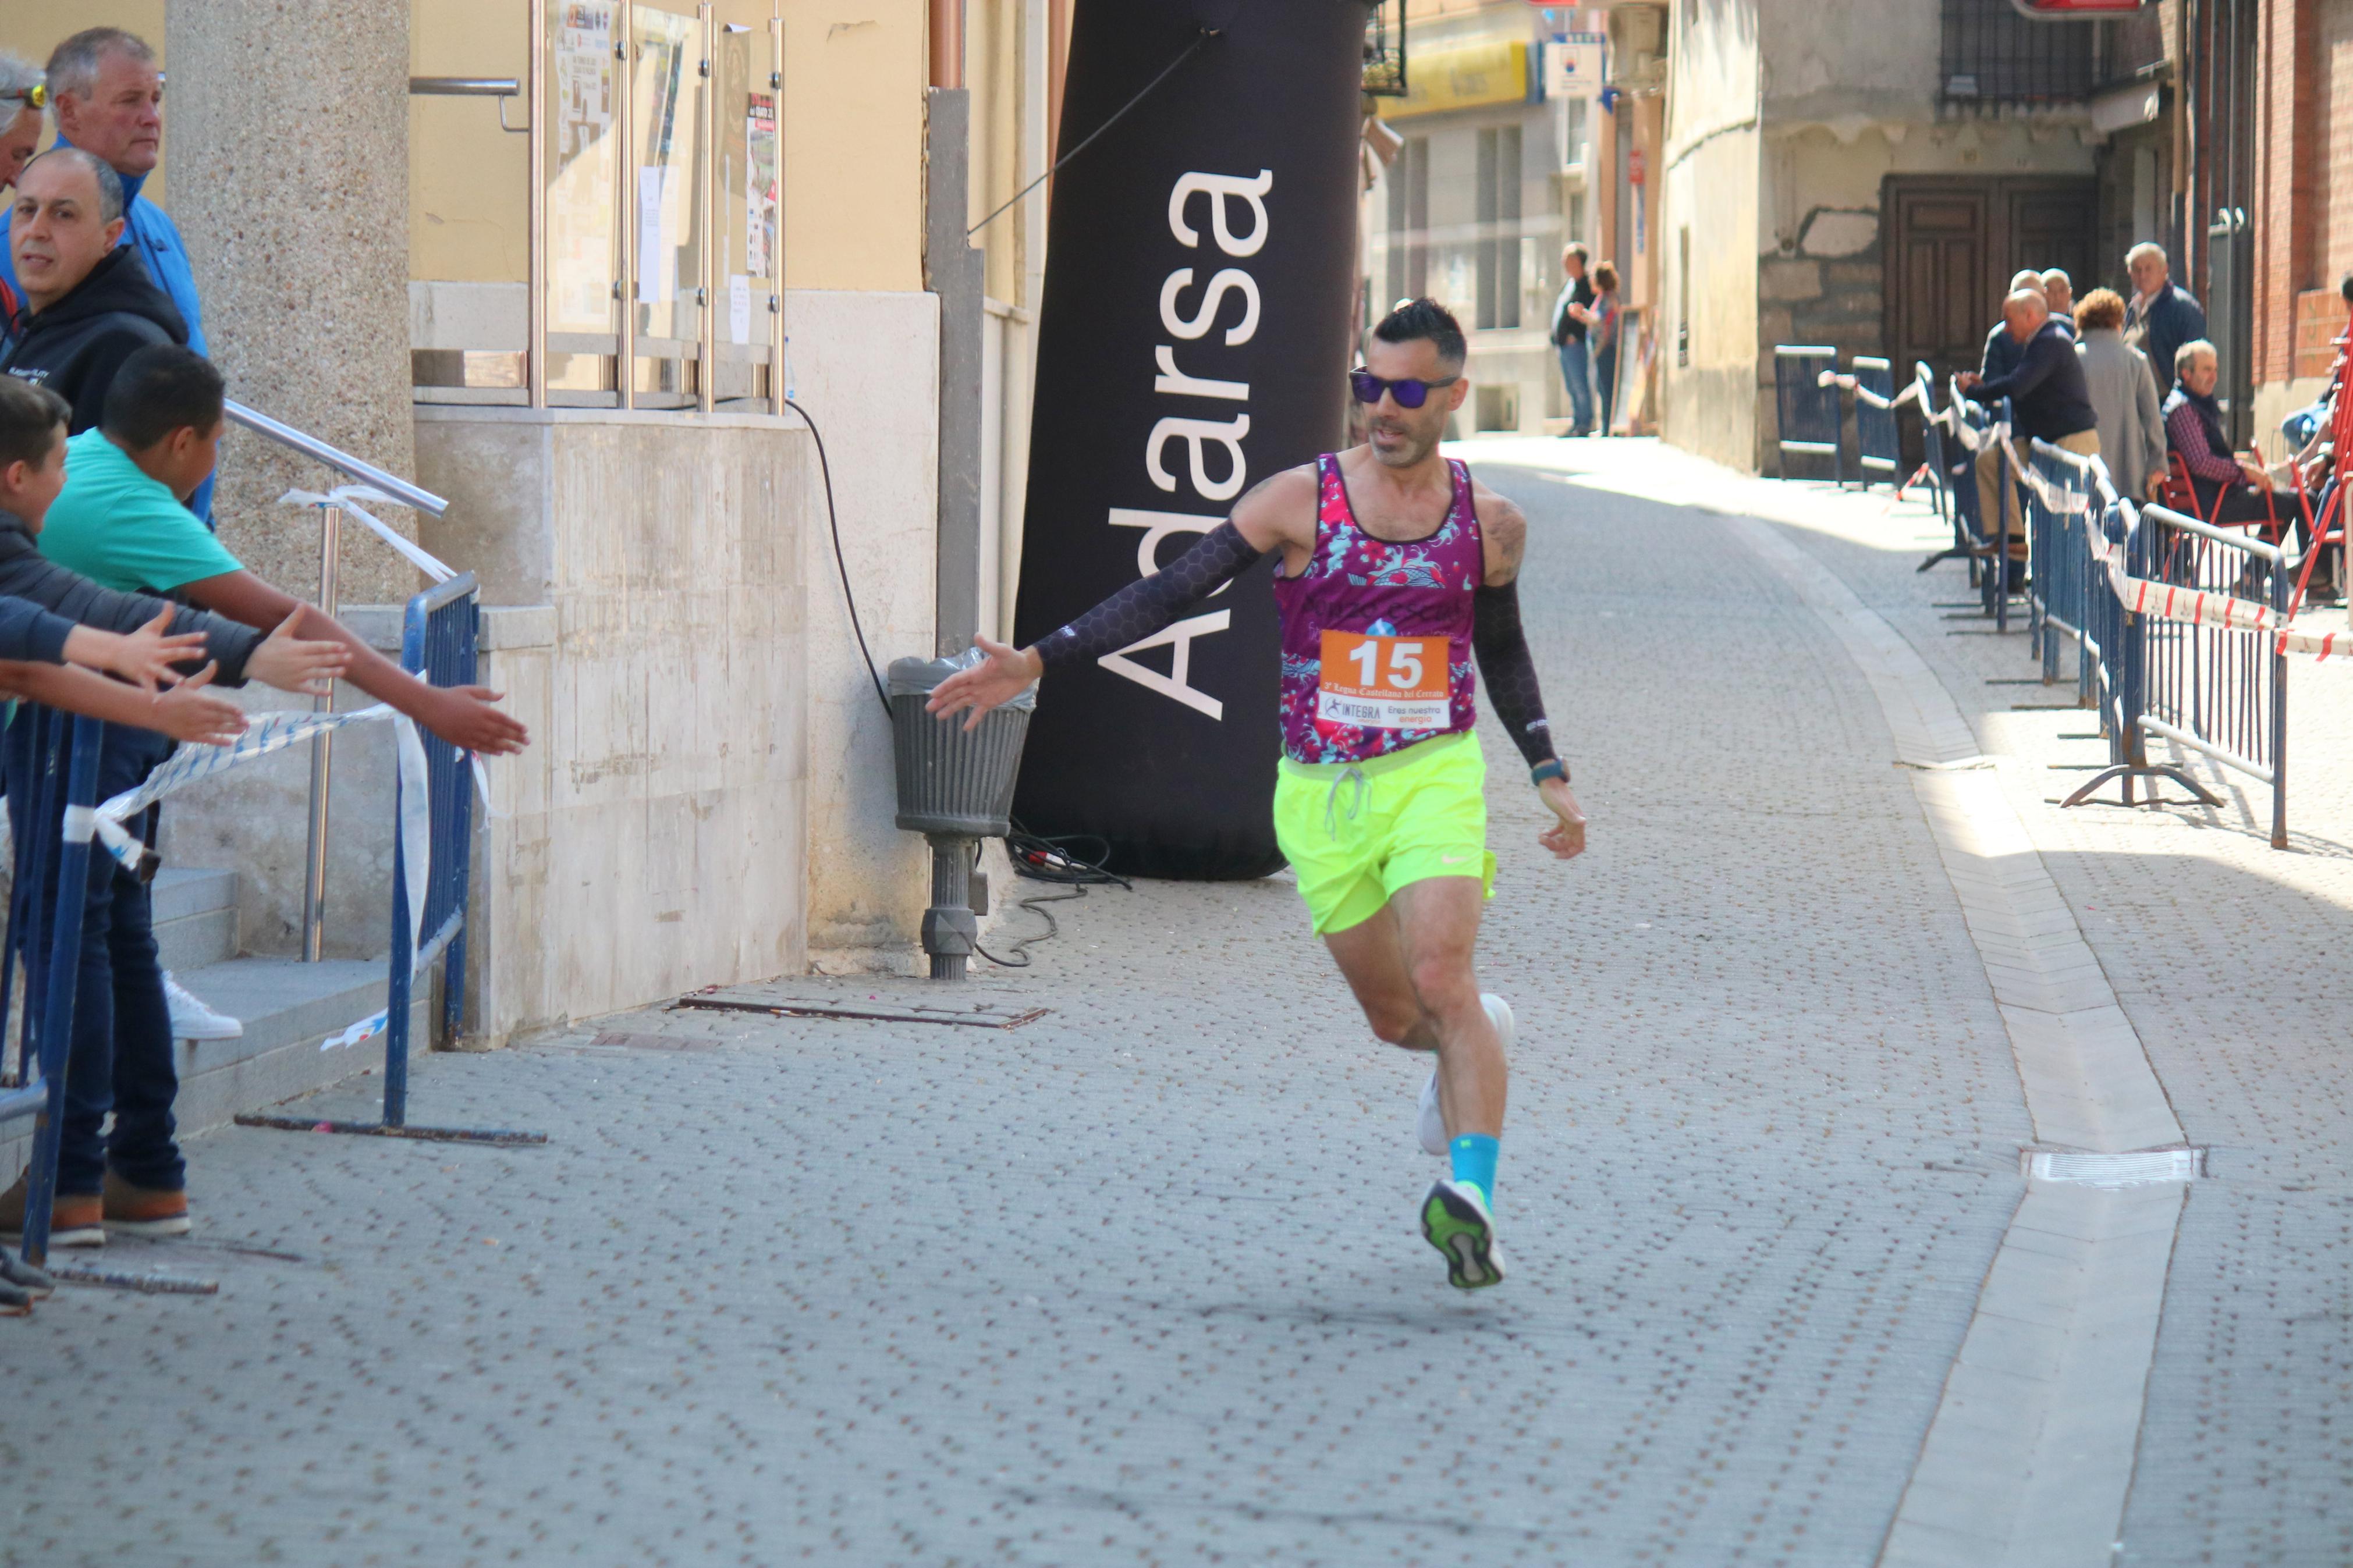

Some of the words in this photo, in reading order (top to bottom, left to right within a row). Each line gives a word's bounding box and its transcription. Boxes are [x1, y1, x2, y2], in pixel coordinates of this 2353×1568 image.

[1098, 168, 1273, 721] Adarsa
[1350, 640, 1424, 689] 15
[1334, 682, 1357, 695] Legua
[1359, 688, 1402, 698] Castellana
[1403, 689, 1414, 698] del
[1415, 689, 1444, 698] Cerrato
[1342, 703, 1380, 719] INTEGRA
[1387, 705, 1406, 714] Eres
[1408, 706, 1441, 714] nuestra
